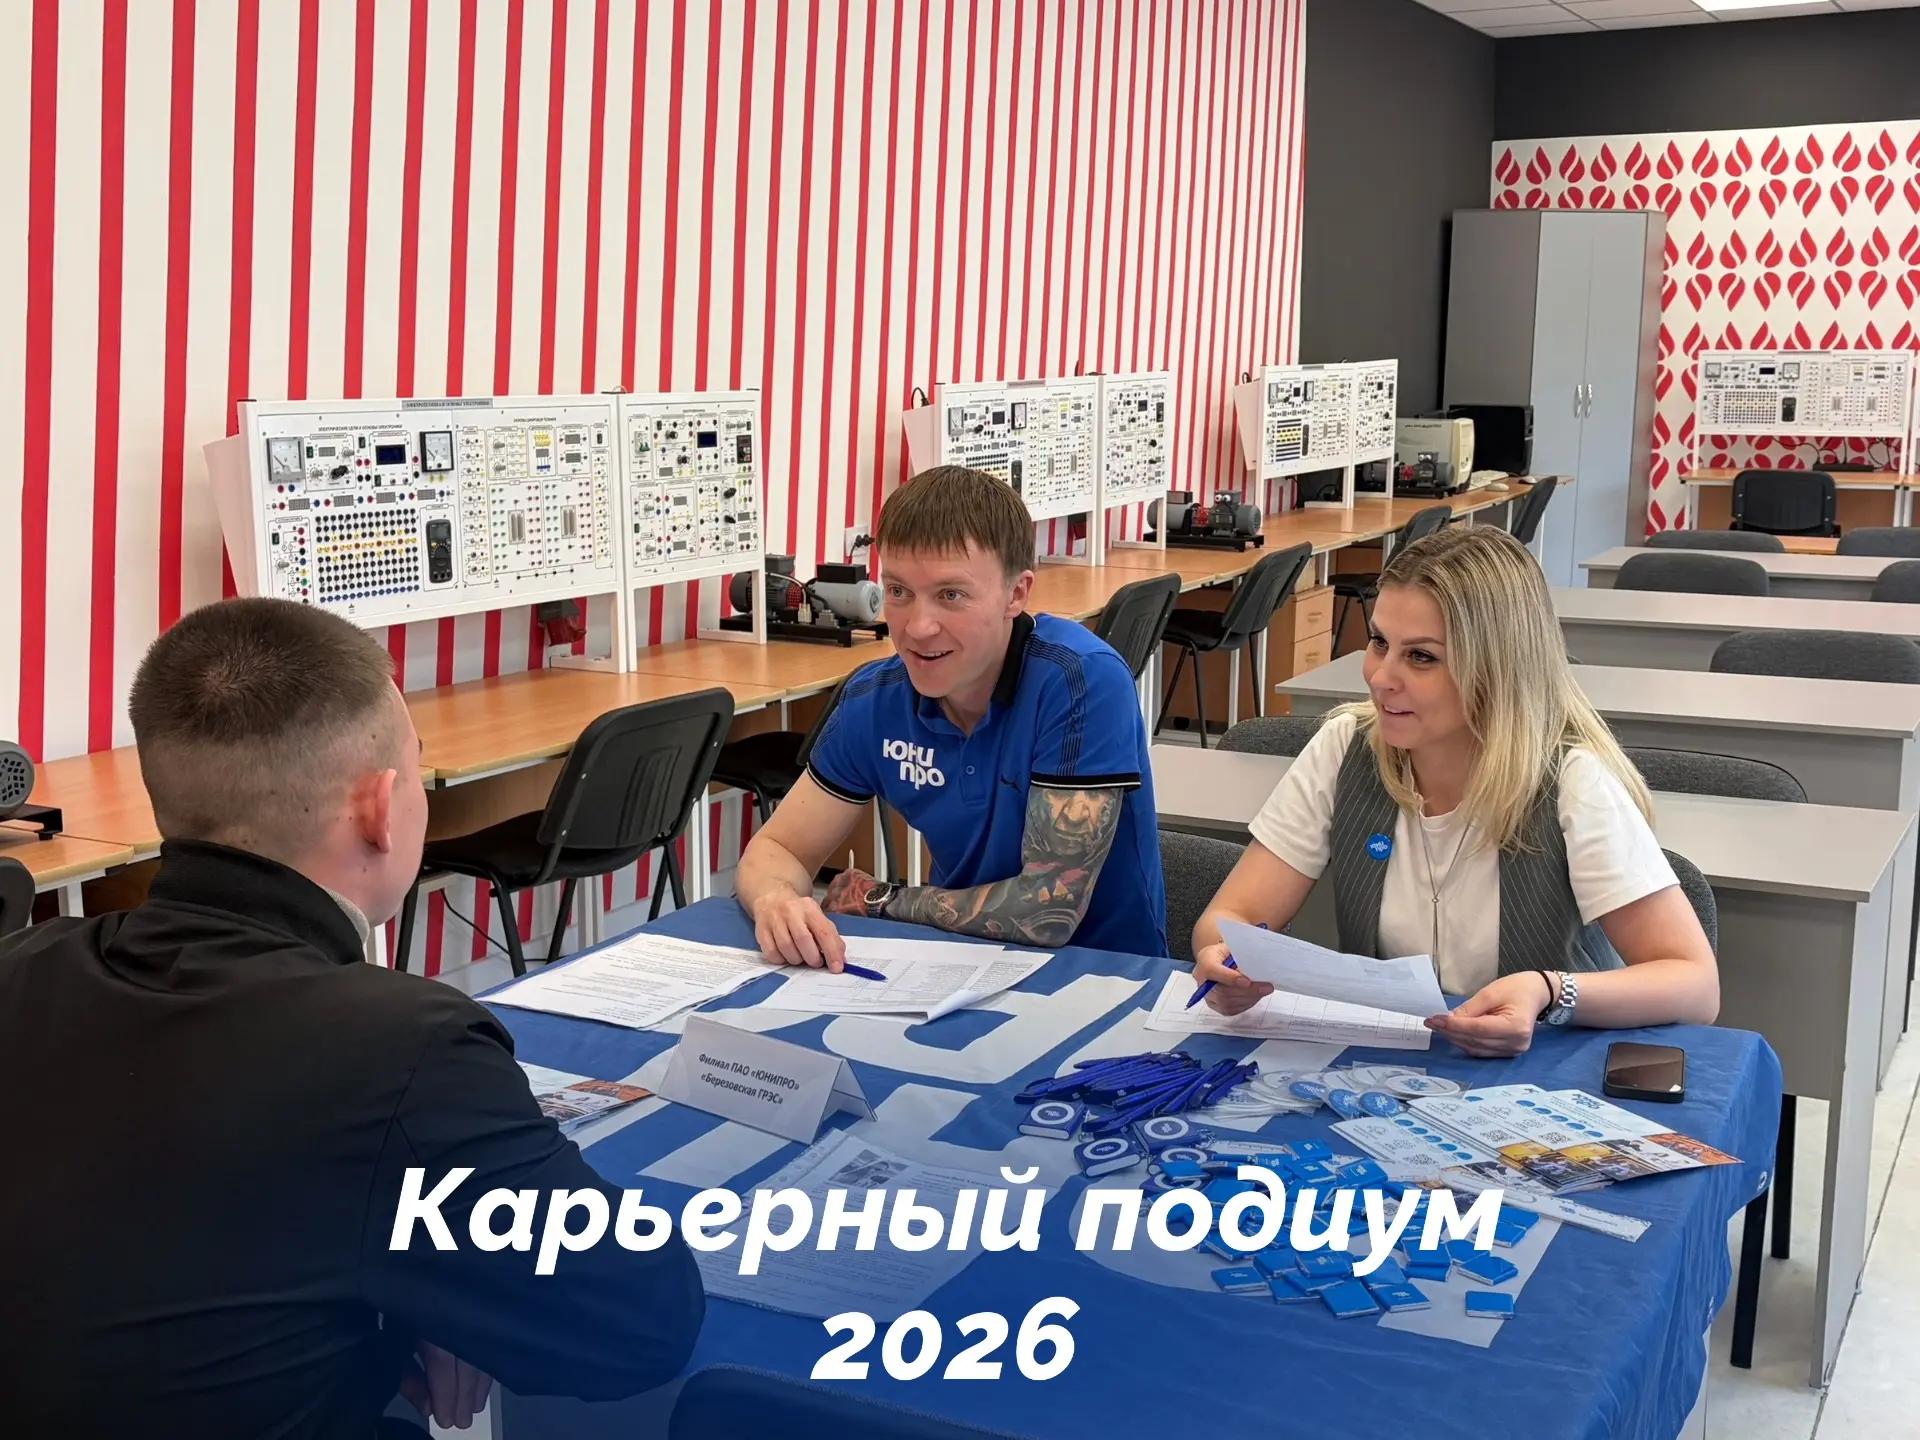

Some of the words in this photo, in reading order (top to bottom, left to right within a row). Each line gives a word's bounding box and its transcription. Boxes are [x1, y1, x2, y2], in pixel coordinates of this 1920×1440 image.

[699, 1053, 730, 1071] Филиал
[730, 1062, 750, 1076] ПАО
[751, 1069, 800, 1091] «ЮНИПРО»
[701, 1073, 757, 1097] «Березовская
[757, 1088, 784, 1105] ГРЭС»
